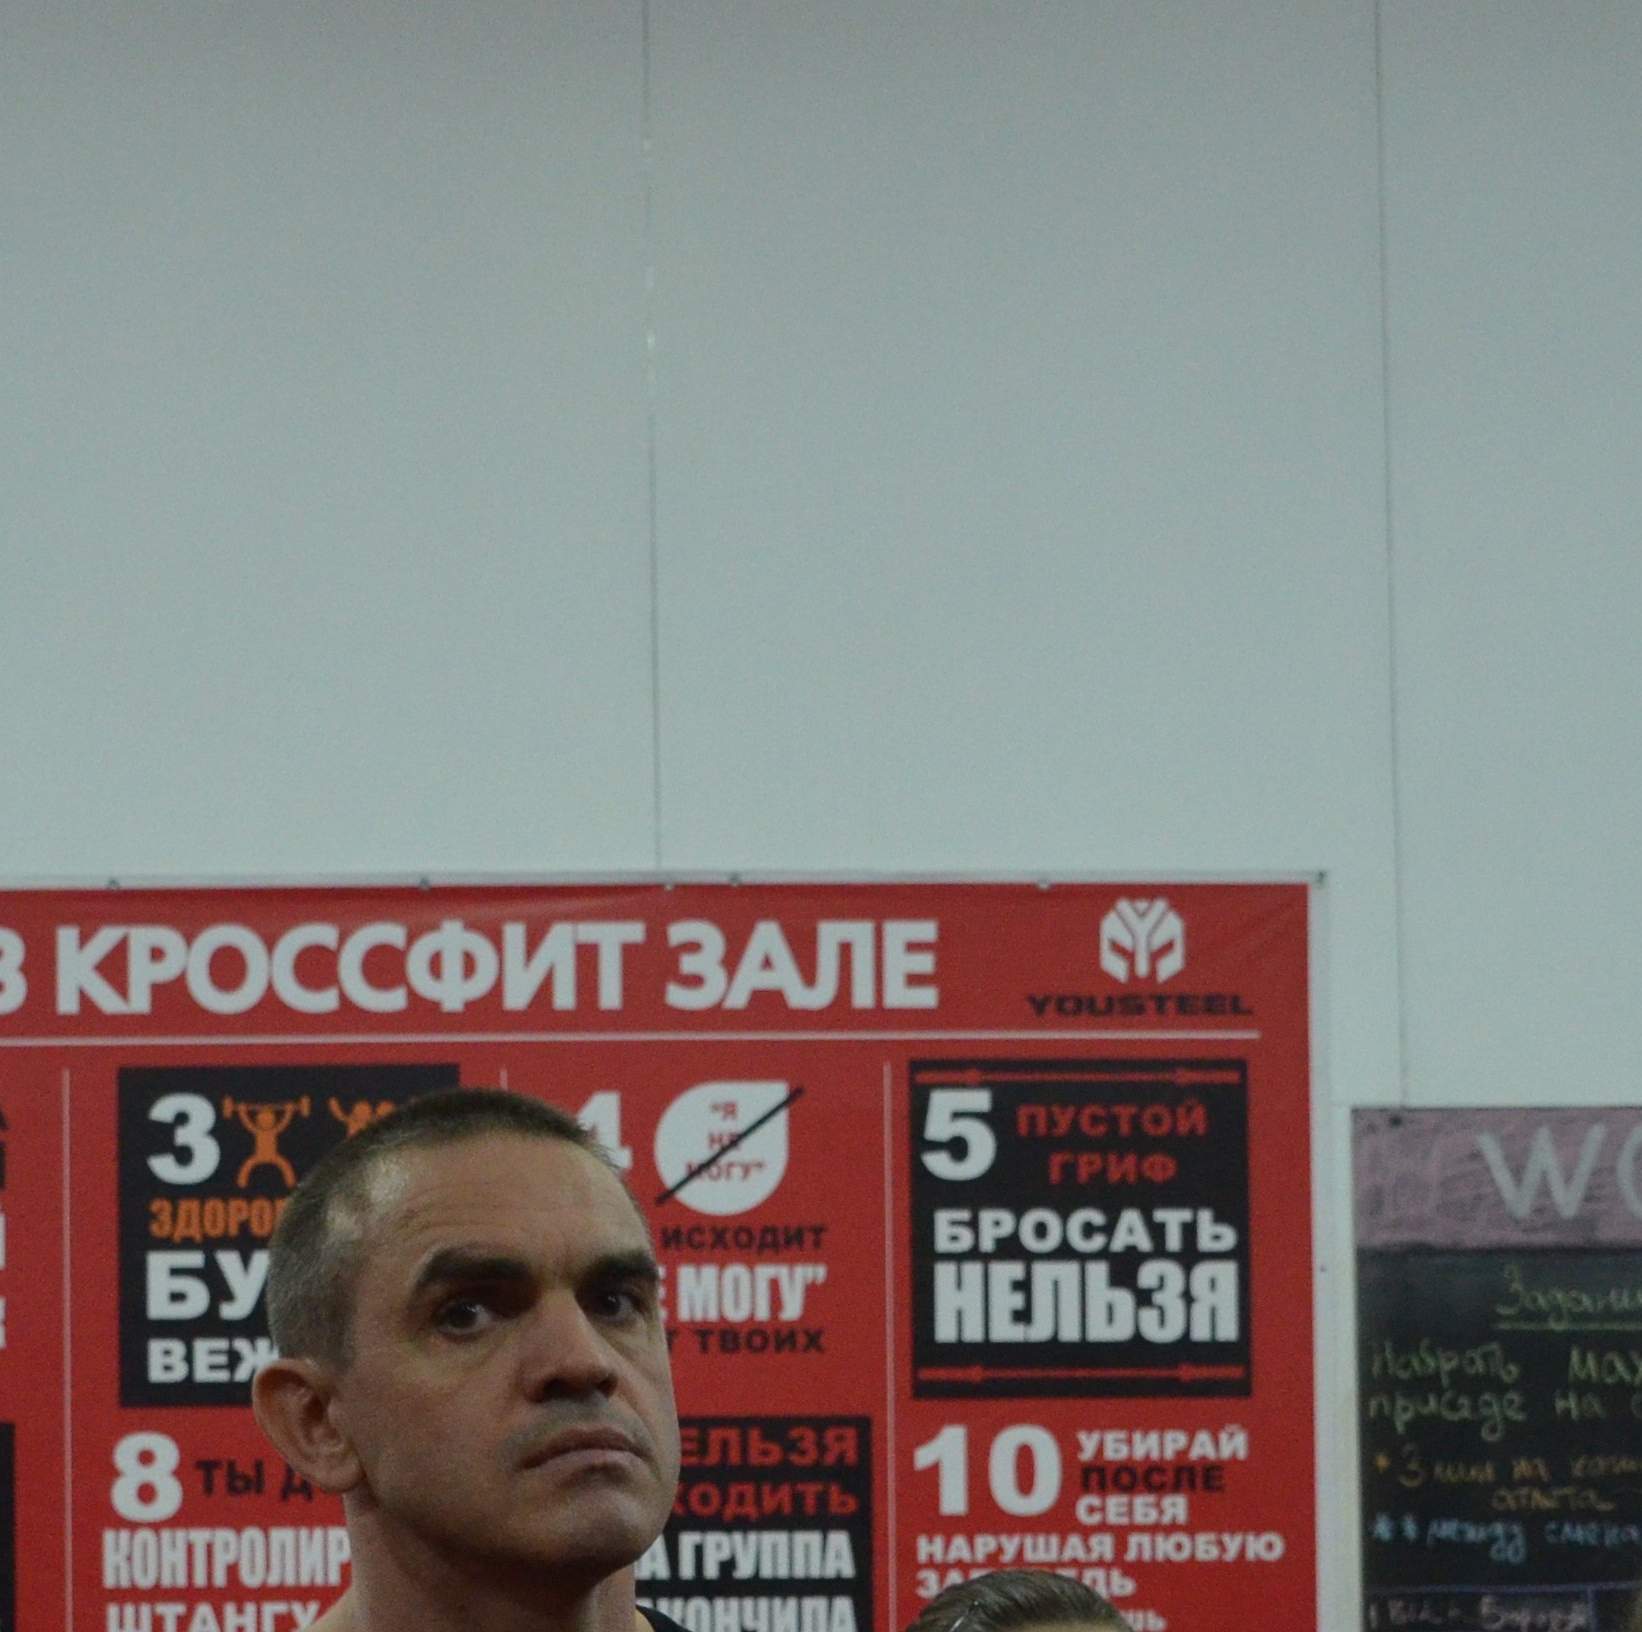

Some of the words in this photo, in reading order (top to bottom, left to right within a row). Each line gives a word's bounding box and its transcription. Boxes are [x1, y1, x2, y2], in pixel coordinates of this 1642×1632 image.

[57, 919, 645, 1016] КРОССФИТ
[663, 919, 939, 1009] ЗАЛЕ
[1027, 993, 1254, 1017] YOUSTEEL
[147, 1092, 221, 1187] 3
[920, 1087, 998, 1182] 5
[1016, 1099, 1211, 1138] ПУСТОЙ
[1047, 1151, 1179, 1185] ГРИФ
[933, 1207, 1238, 1255] БРОСАТЬ
[146, 1248, 271, 1321] БУ
[933, 1259, 1240, 1344] НЕЛЬЗЯ
[146, 1337, 280, 1384] ВЕЖ
[695, 1328, 825, 1353] ТВОИХ
[680, 1426, 859, 1467] ЕЛЬЗЯ
[1076, 1423, 1249, 1464] УБИРАЙ
[110, 1431, 183, 1523] 8
[196, 1459, 266, 1497] ТЫ
[913, 1424, 1062, 1518] 10
[1080, 1464, 1226, 1494] ПОСЛЕ
[1076, 1494, 1189, 1526] СЕБЯ
[103, 1526, 352, 1590] КОНТРОЛИР
[677, 1530, 856, 1580] ГРУППА
[916, 1533, 1113, 1565] НАРУШАЯ
[1123, 1530, 1286, 1564] ЛЮБУЮ
